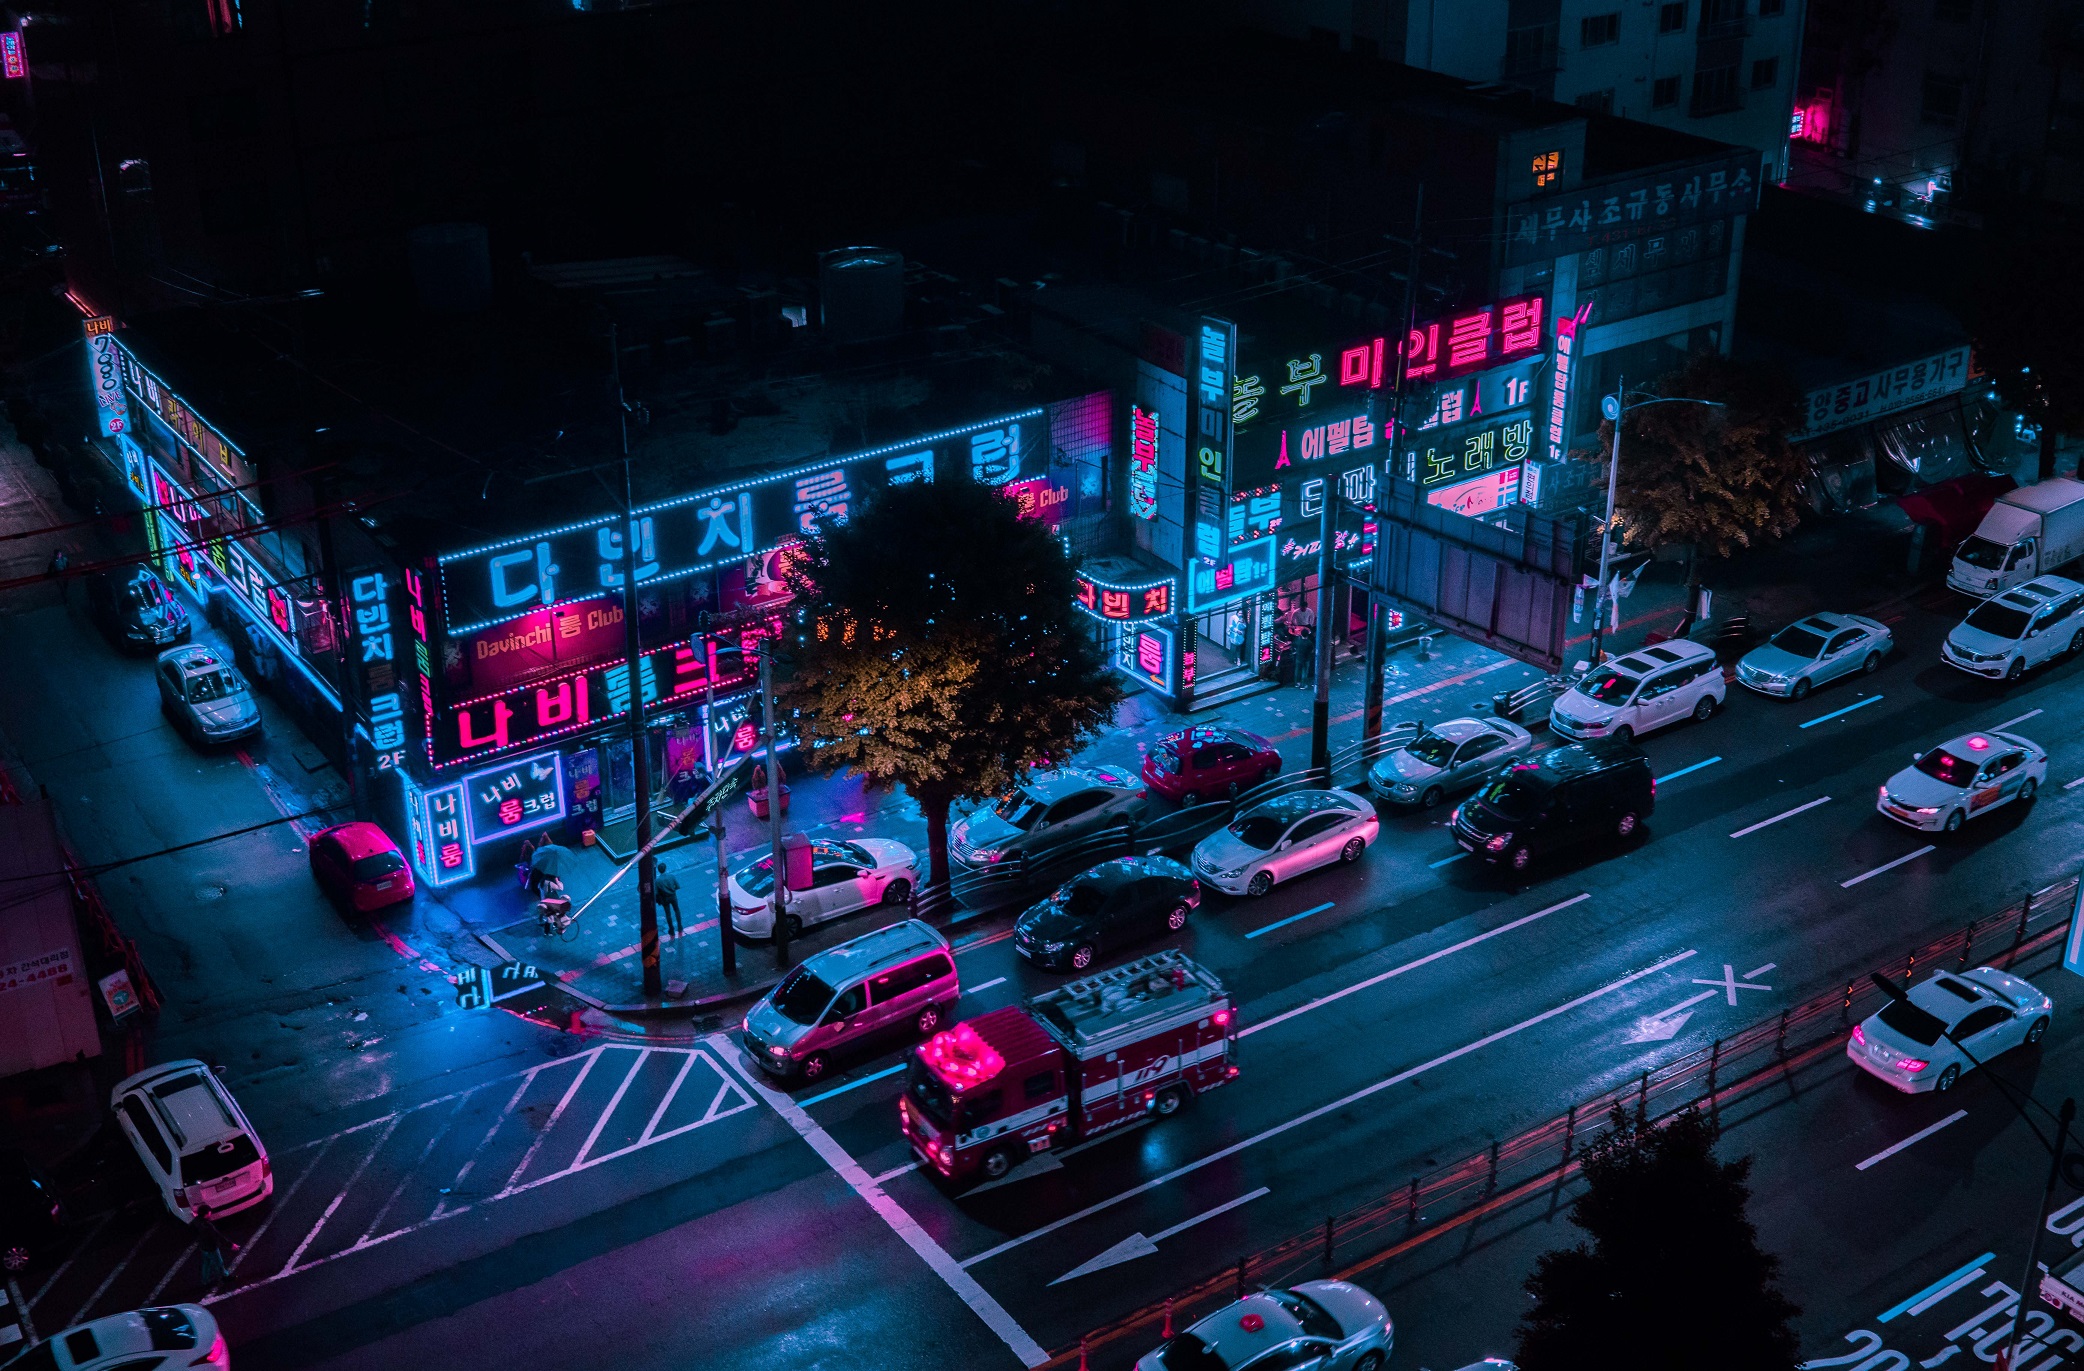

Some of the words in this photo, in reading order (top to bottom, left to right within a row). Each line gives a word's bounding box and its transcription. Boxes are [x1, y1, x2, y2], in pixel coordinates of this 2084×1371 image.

[87, 320, 111, 334] 나비
[95, 336, 117, 391] 7080
[1506, 377, 1530, 405] 1F
[110, 420, 123, 431] 2F
[1039, 485, 1069, 507] Club
[476, 621, 552, 660] Davinchi
[559, 614, 582, 639] 룸
[588, 606, 624, 631] Club
[376, 749, 407, 770] 2F
[481, 772, 522, 805] 나비
[1133, 1054, 1171, 1085] 119
